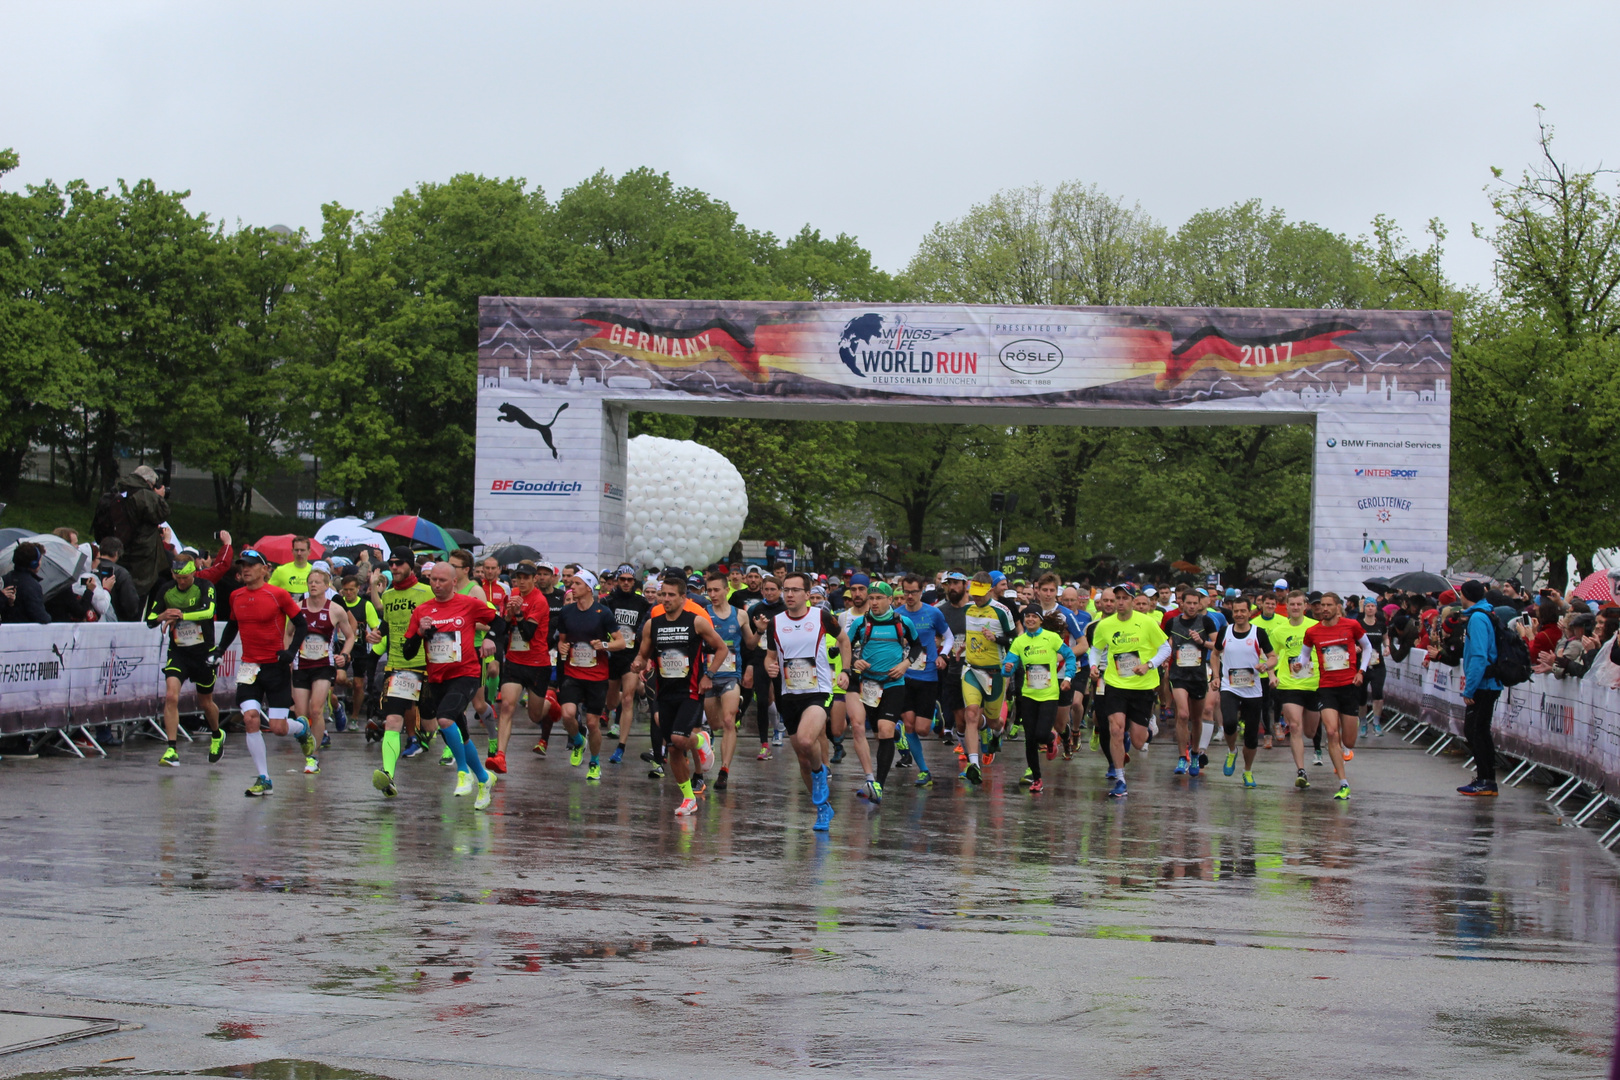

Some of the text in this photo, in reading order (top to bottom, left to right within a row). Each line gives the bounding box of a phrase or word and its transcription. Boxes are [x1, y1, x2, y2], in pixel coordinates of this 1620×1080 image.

[882, 327, 933, 341] WINGS
[996, 324, 1051, 332] PRESENTED
[609, 323, 713, 358] GERMANY
[888, 339, 916, 350] LIFE
[1005, 349, 1057, 361] RÖSLE
[1240, 342, 1293, 367] 2017
[862, 350, 977, 375] WORLD RUN
[872, 375, 977, 385] DEUTSCHLAND MÜNCHEN
[1341, 439, 1442, 449] BMW Financial Services
[1364, 468, 1418, 478] INTERSPORT
[491, 480, 582, 492] BFGoodrich
[1357, 496, 1412, 512] GEROLSTEINER
[1361, 556, 1409, 564] OLYMPIAPARK
[385, 600, 416, 613] Flock
[657, 626, 689, 634] POSITIV
[3, 662, 37, 683] FASTER
